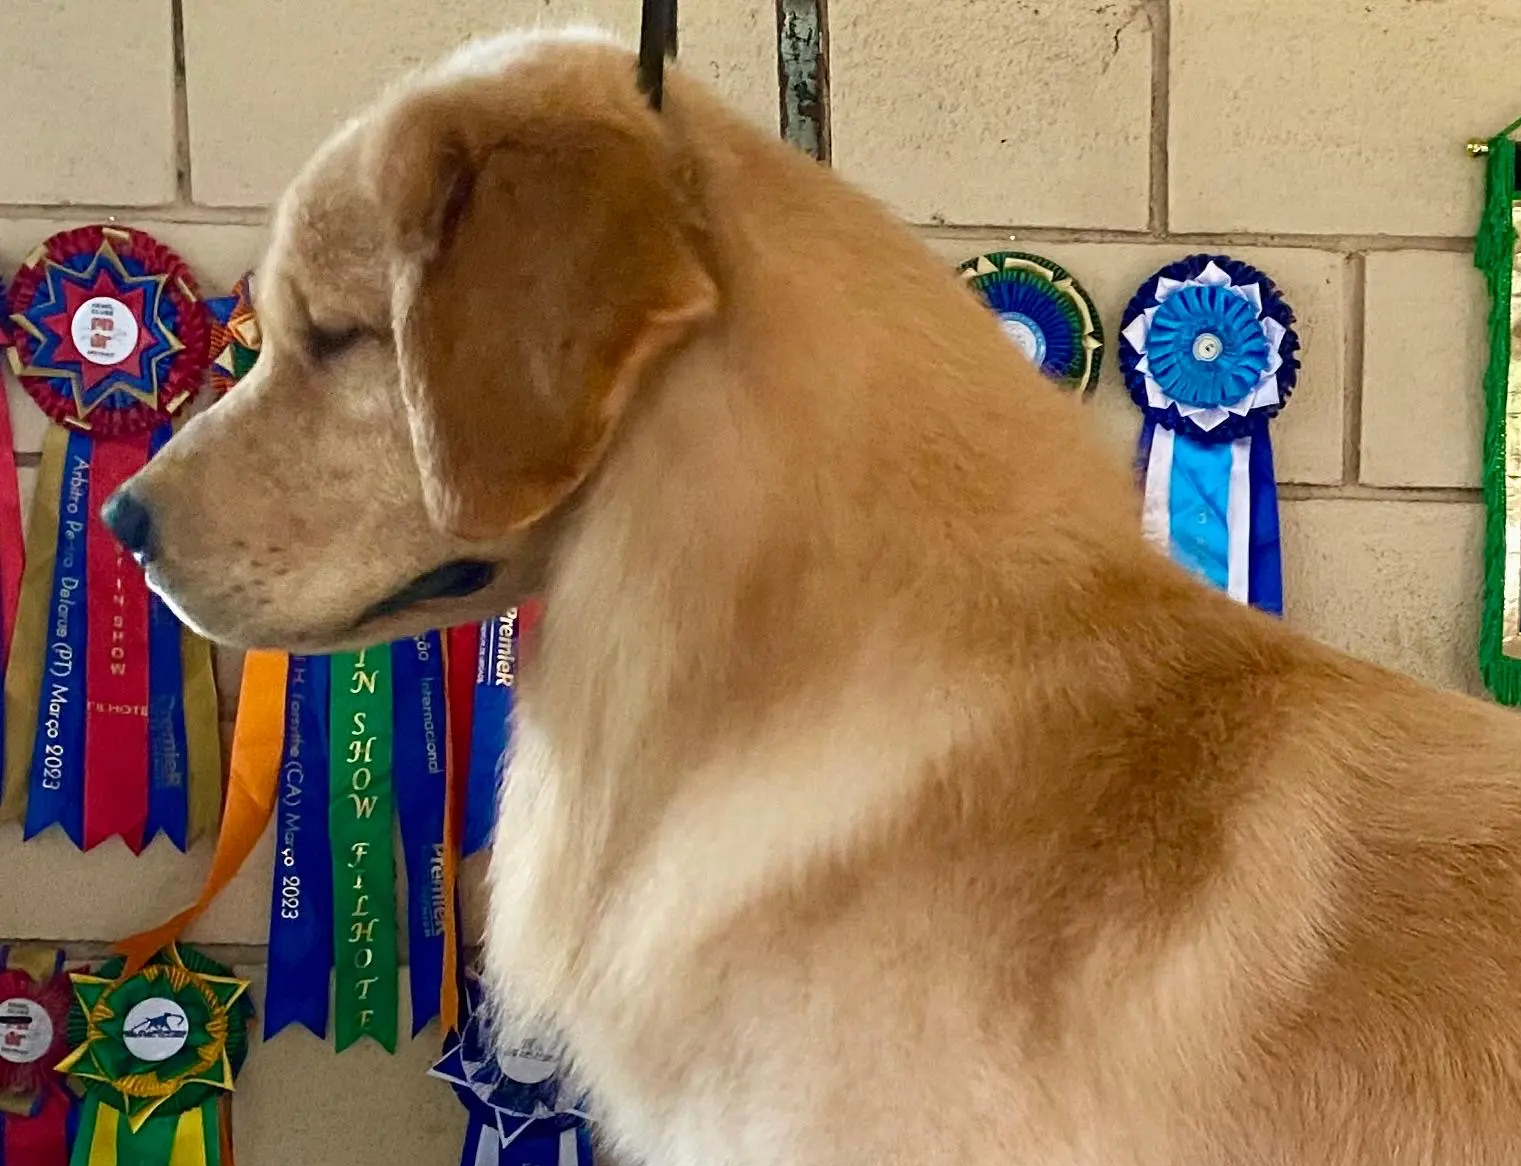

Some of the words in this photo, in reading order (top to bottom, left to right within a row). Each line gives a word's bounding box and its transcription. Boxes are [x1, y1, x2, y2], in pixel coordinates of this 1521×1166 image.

[50, 642, 72, 677] (PT)
[45, 683, 69, 739] Março
[42, 745, 64, 790] 2023
[283, 760, 303, 807] (CA)
[346, 712, 378, 819] SHOW
[281, 876, 300, 919] 2023
[347, 842, 379, 1031] FILHOTE
